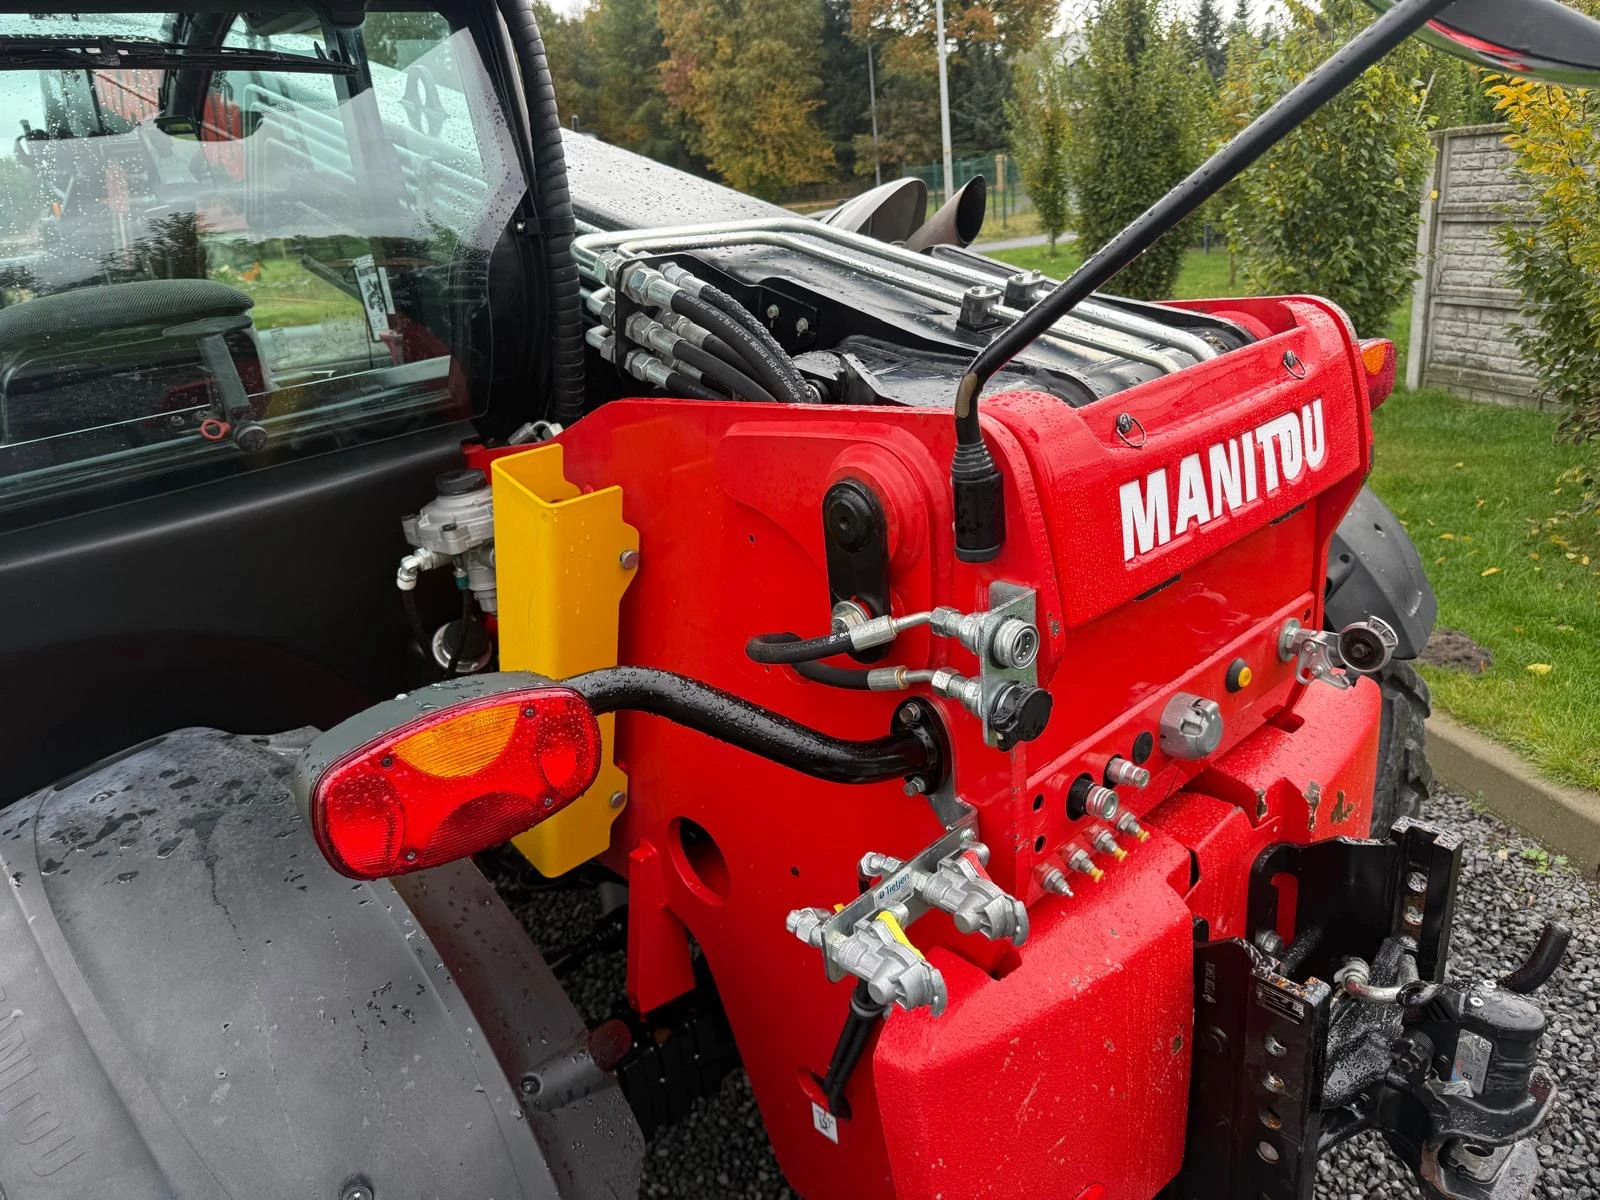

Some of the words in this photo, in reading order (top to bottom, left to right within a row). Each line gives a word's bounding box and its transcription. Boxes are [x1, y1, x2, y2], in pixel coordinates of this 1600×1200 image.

[750, 341, 769, 359] MSHA
[1118, 398, 1327, 564] MANITOU
[885, 873, 910, 895] Tietjen
